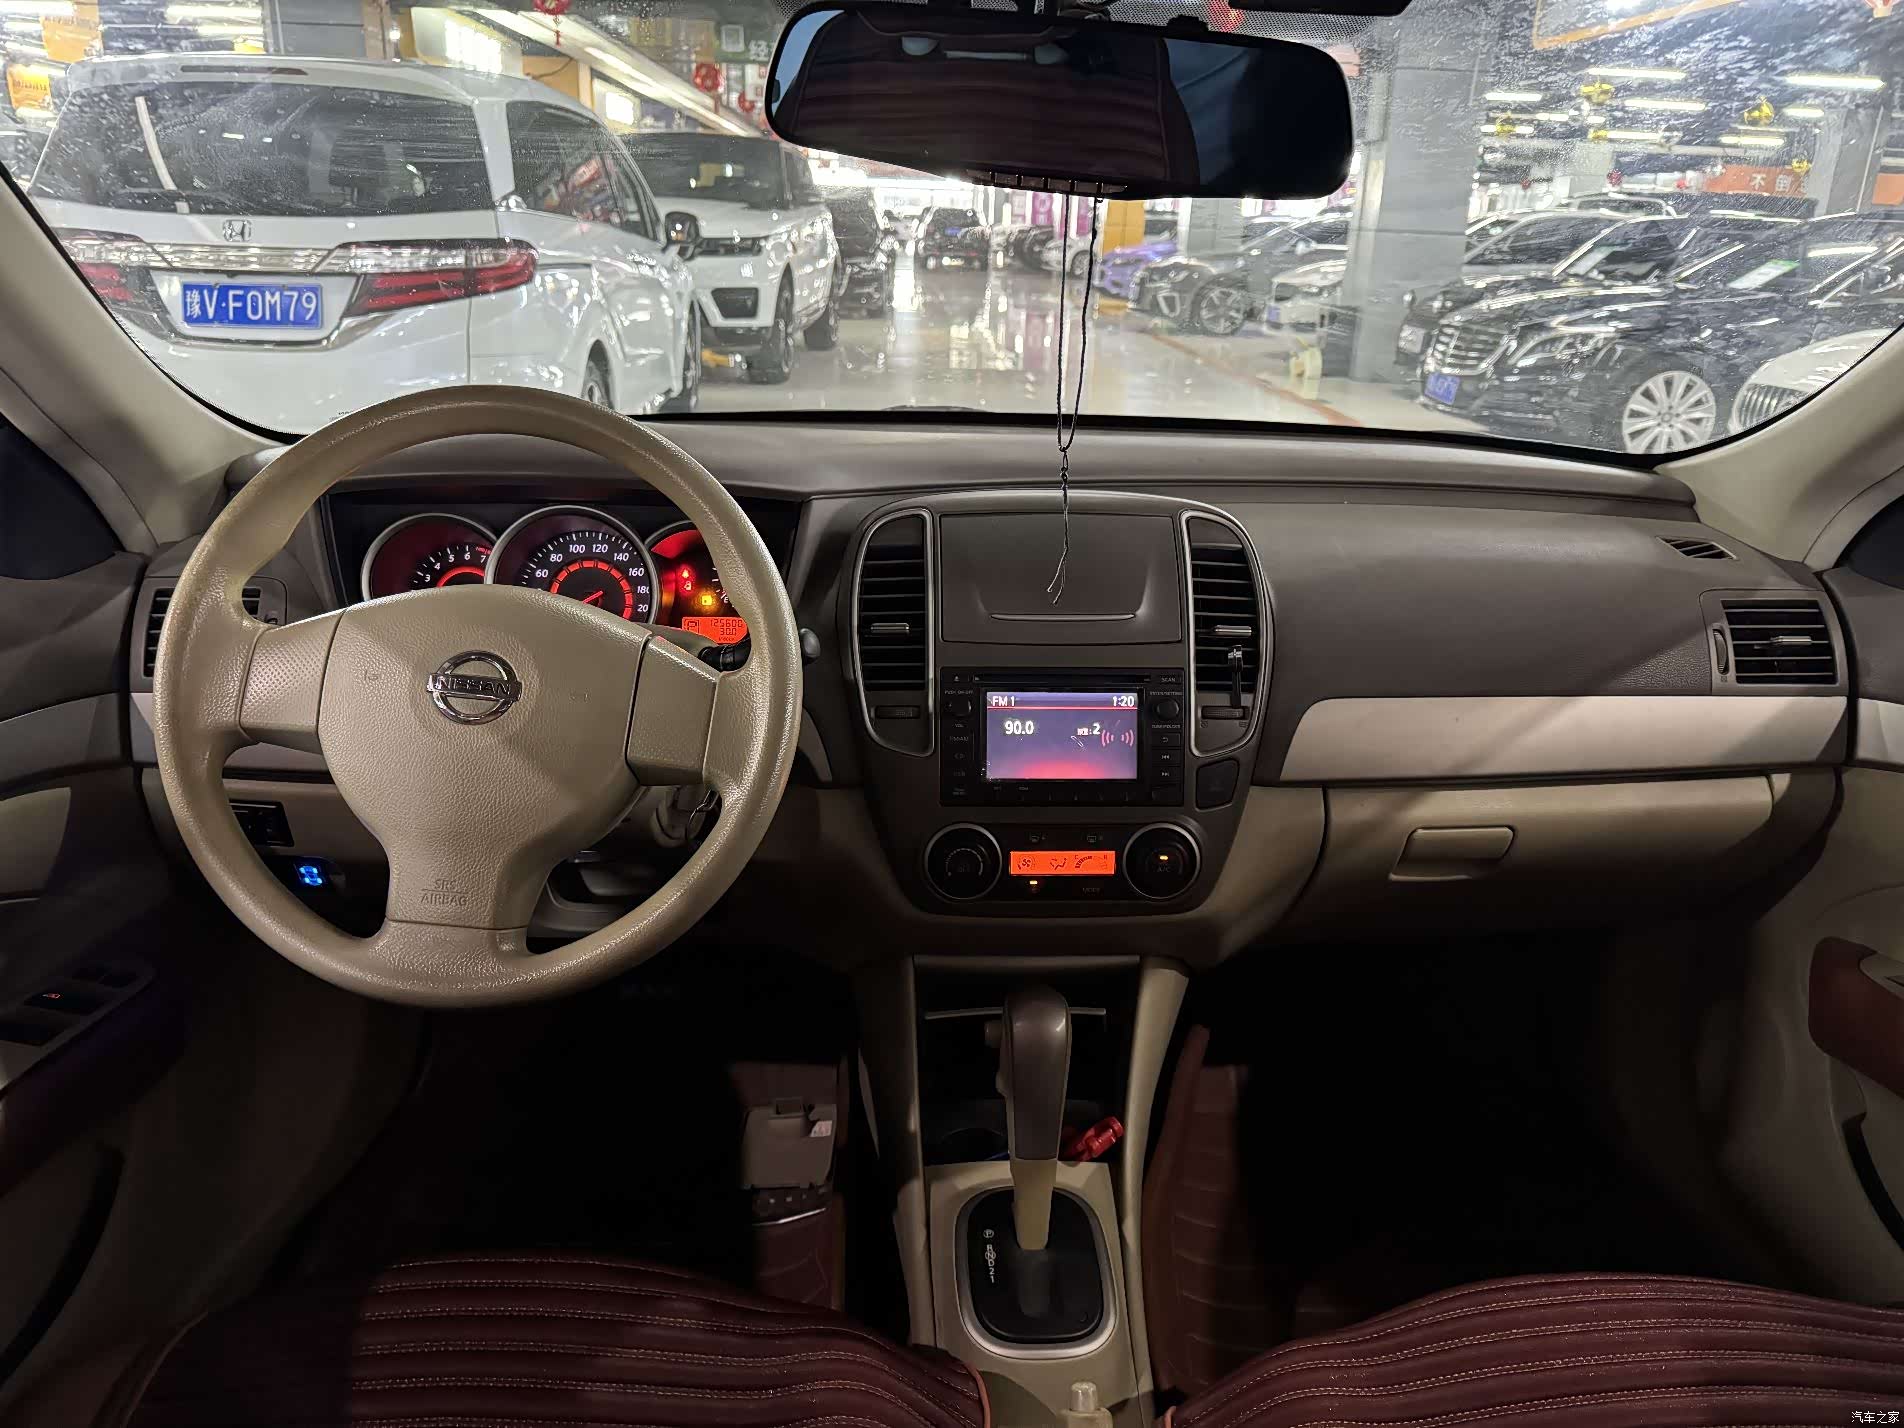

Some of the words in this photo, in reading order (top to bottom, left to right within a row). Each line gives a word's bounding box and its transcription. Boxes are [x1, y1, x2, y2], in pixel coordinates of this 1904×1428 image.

[569, 544, 585, 554] 100
[592, 544, 608, 553] 120
[448, 554, 455, 563] 5
[464, 552, 470, 560] 6
[480, 555, 487, 563] 7
[550, 553, 563, 563] 80
[613, 553, 629, 562] 140
[434, 562, 441, 570] 4
[535, 569, 548, 578] 60
[629, 567, 645, 577] 160
[711, 618, 743, 628] 125600
[435, 676, 511, 695] NISSAN
[992, 696, 1008, 707] FM
[1010, 696, 1015, 707] 1
[1112, 696, 1135, 707] 1:20
[1004, 720, 1035, 735] 90.0
[420, 893, 467, 906] AIRBAG
